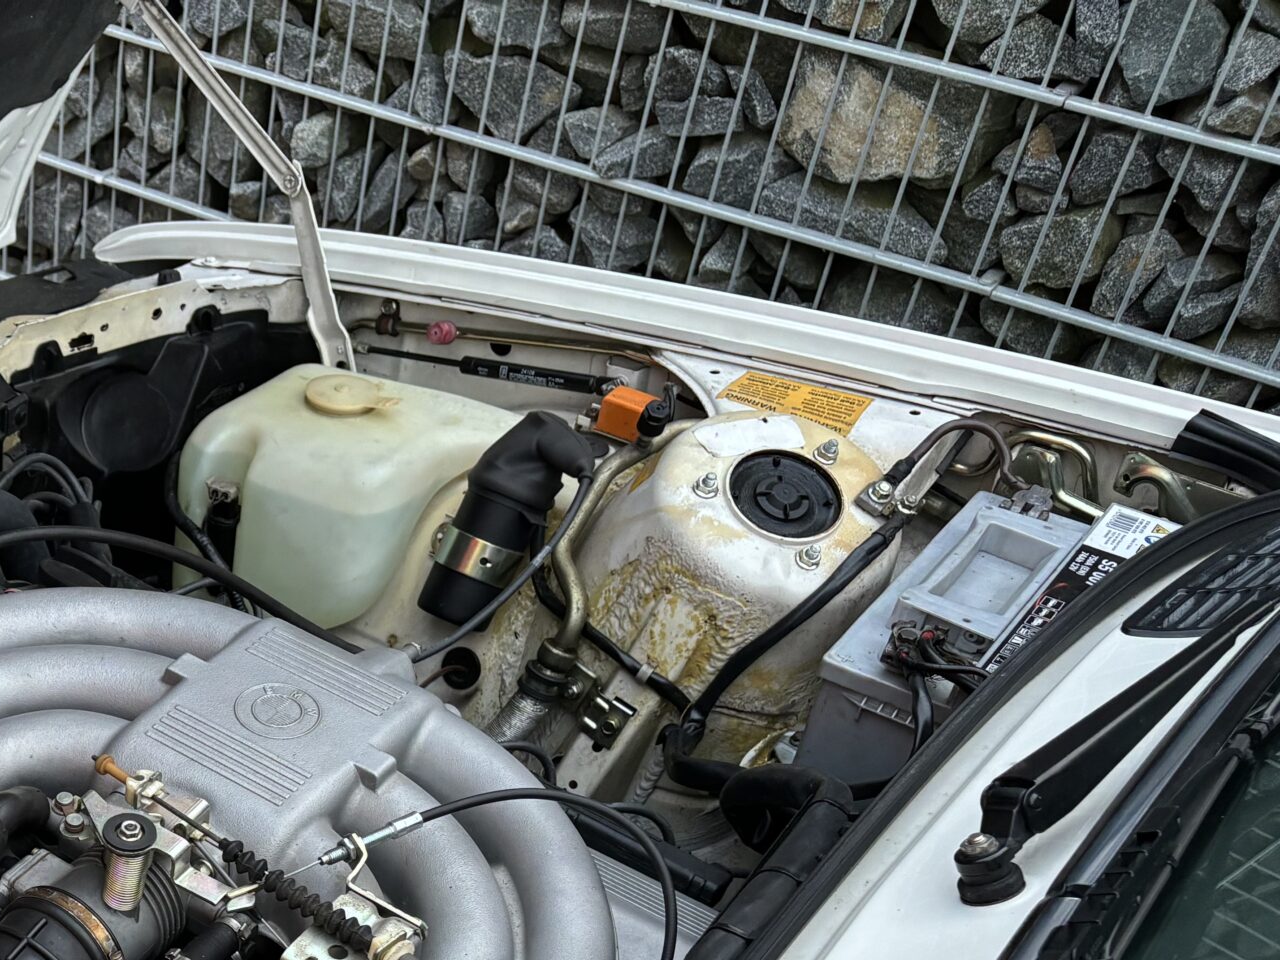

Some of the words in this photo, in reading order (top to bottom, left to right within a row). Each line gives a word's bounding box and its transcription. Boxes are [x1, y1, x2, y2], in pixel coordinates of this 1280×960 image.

[724, 391, 776, 412] WARNING
[1067, 561, 1080, 571] 12V
[1096, 558, 1118, 572] S5
